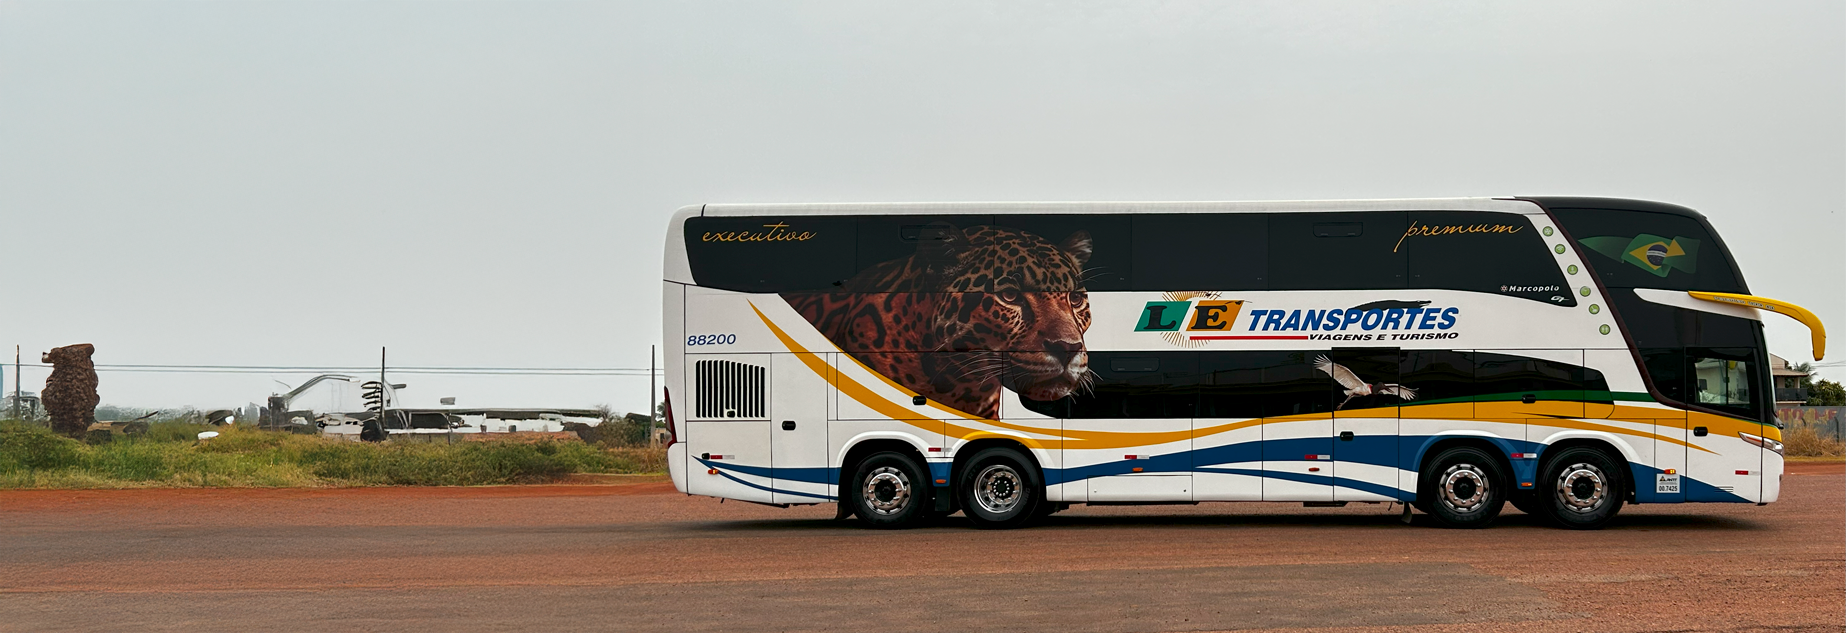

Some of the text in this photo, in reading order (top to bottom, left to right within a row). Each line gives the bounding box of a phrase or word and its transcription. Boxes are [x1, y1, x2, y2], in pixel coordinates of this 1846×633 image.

[702, 221, 817, 242] executivo
[1393, 220, 1523, 252] premium
[1509, 285, 1560, 293] Marcopolo
[1249, 307, 1460, 332] TRANSPORTES
[687, 333, 737, 346] 88200
[1309, 332, 1459, 341] VIAGENS E TURISMO
